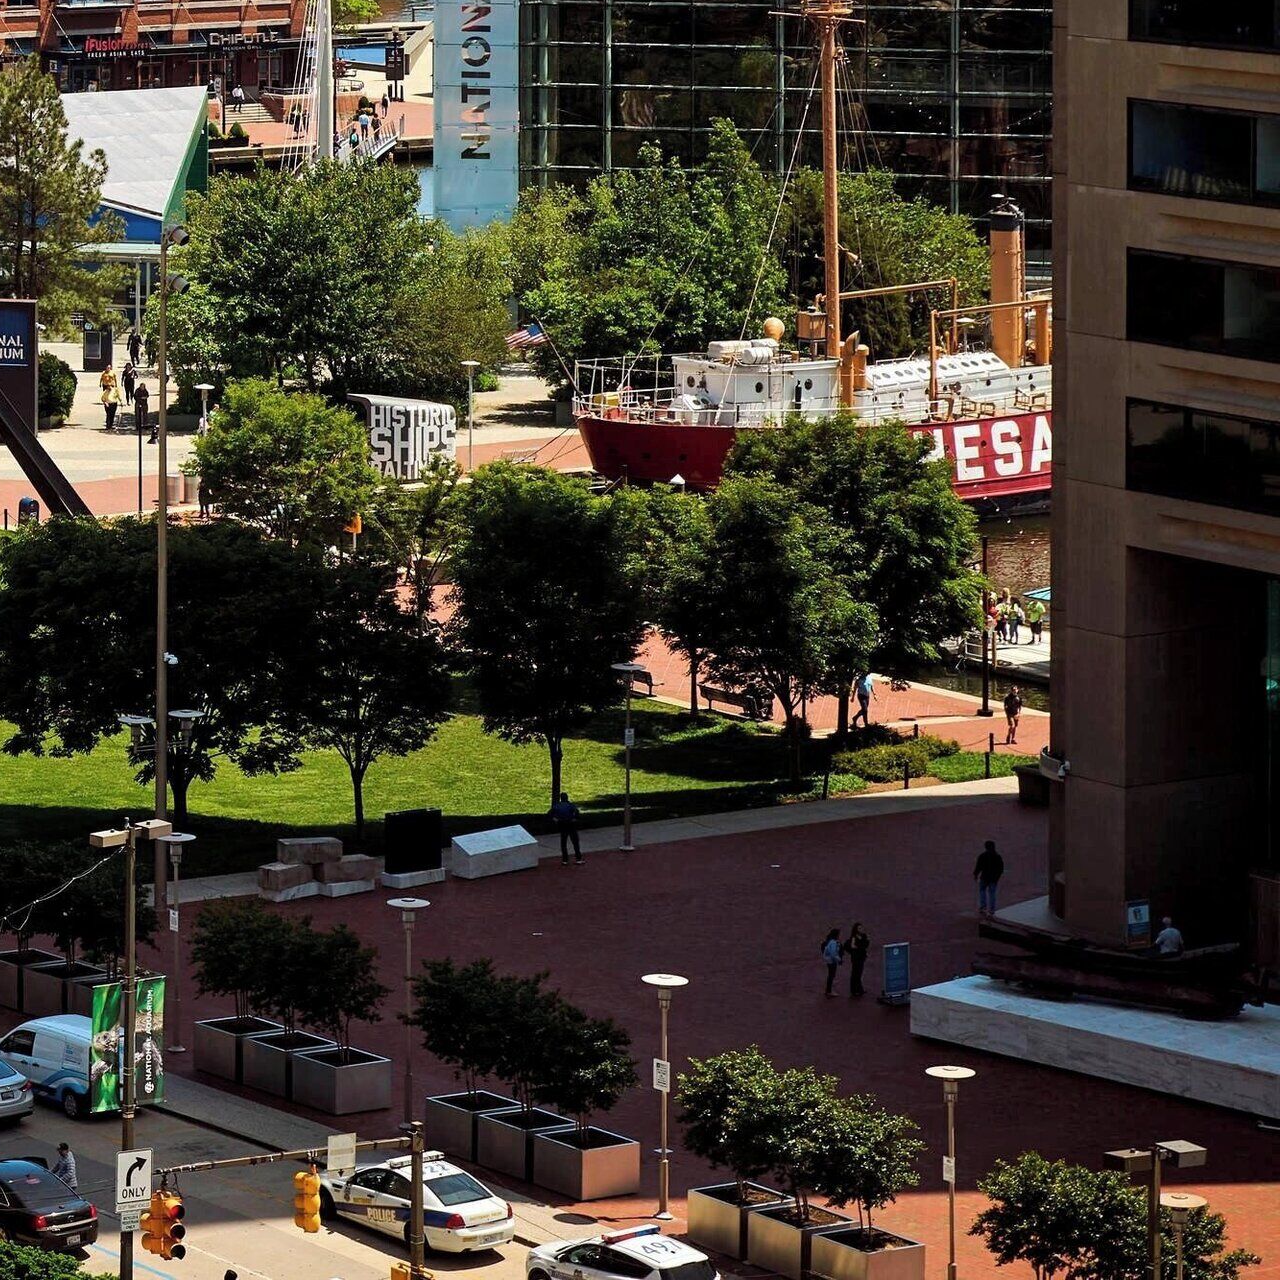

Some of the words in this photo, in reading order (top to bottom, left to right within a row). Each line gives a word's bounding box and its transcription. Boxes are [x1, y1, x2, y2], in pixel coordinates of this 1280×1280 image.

[209, 32, 279, 46] CHIPOTLE
[371, 405, 456, 428] HISTORIC
[371, 426, 456, 461] SHIPS
[122, 1187, 146, 1199] ONLY
[366, 1207, 396, 1222] POLICE
